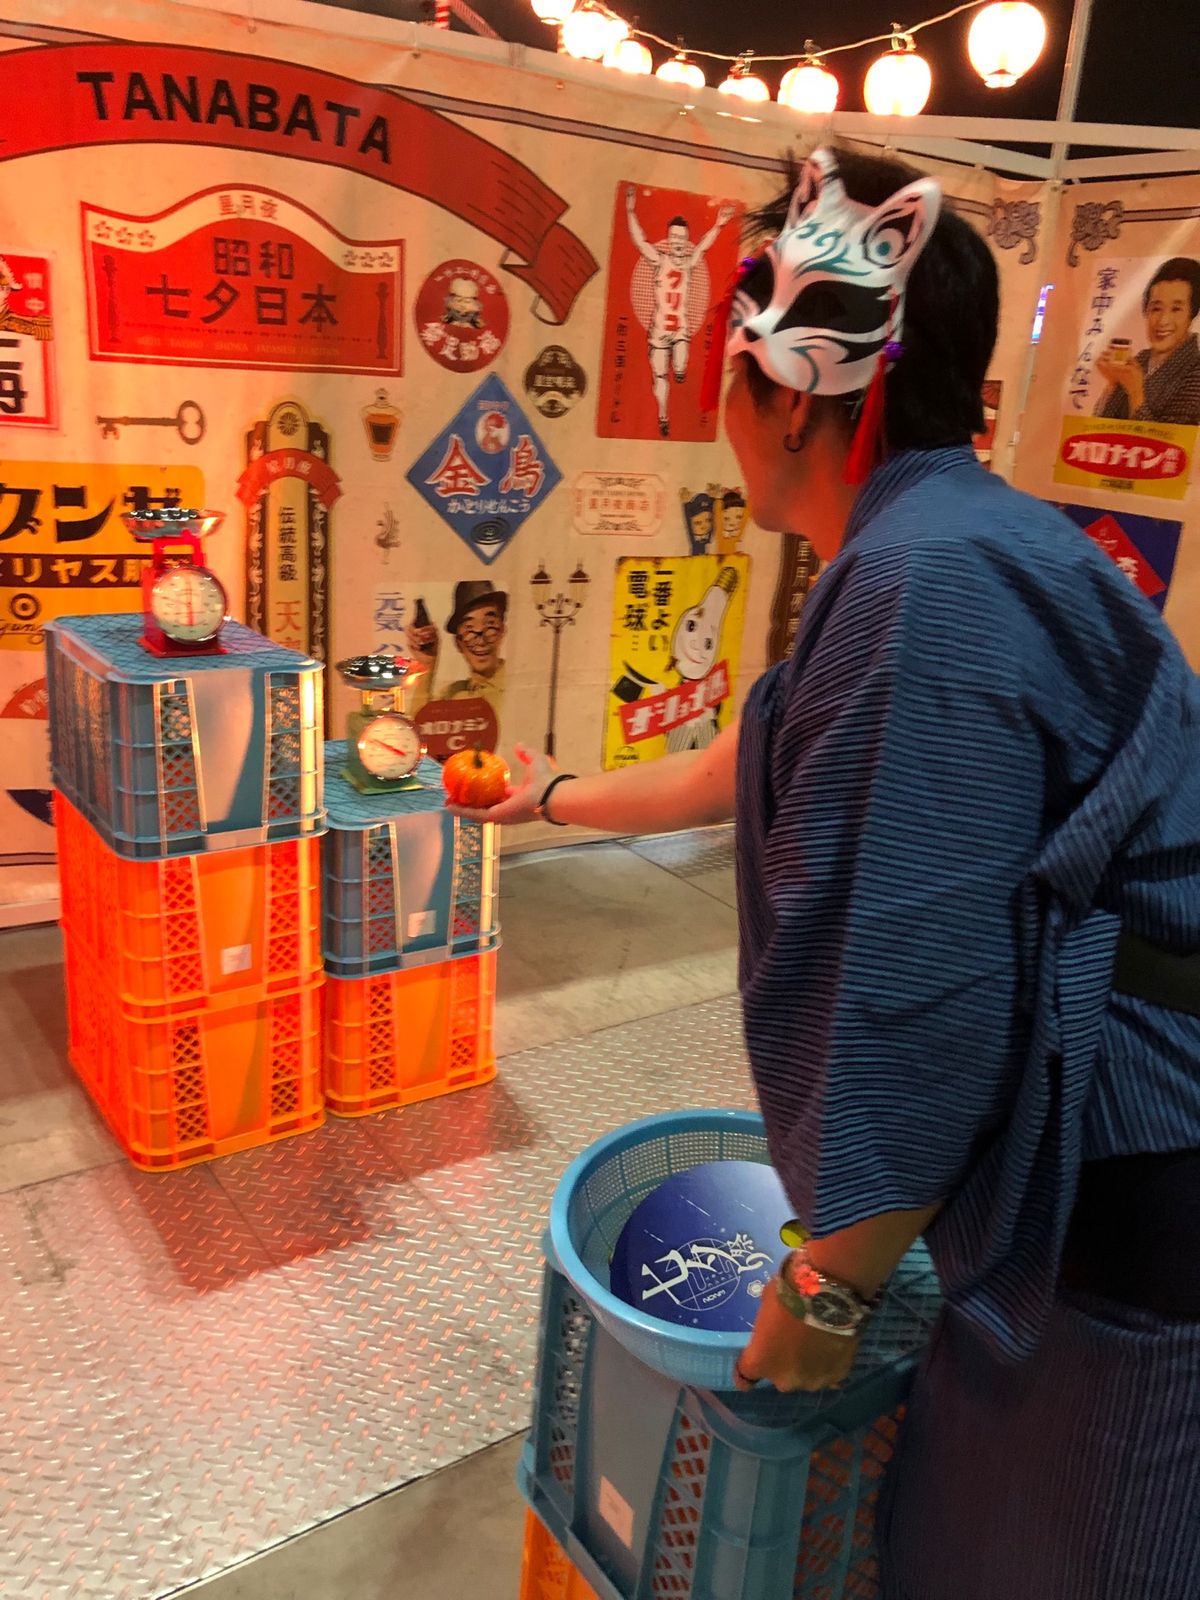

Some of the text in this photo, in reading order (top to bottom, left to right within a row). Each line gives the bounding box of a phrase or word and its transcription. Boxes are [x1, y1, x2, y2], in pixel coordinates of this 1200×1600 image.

[77, 71, 392, 165] TANABATA
[213, 235, 296, 281] 昭和
[145, 274, 339, 333] 七夕日本
[424, 433, 545, 498] 金鳥
[1067, 440, 1166, 470] オロナイン
[623, 569, 649, 631] 電球
[649, 569, 675, 652] 一番よい
[419, 717, 489, 735] オロナミン
[625, 668, 728, 736] ナショナル
[446, 735, 469, 750] C
